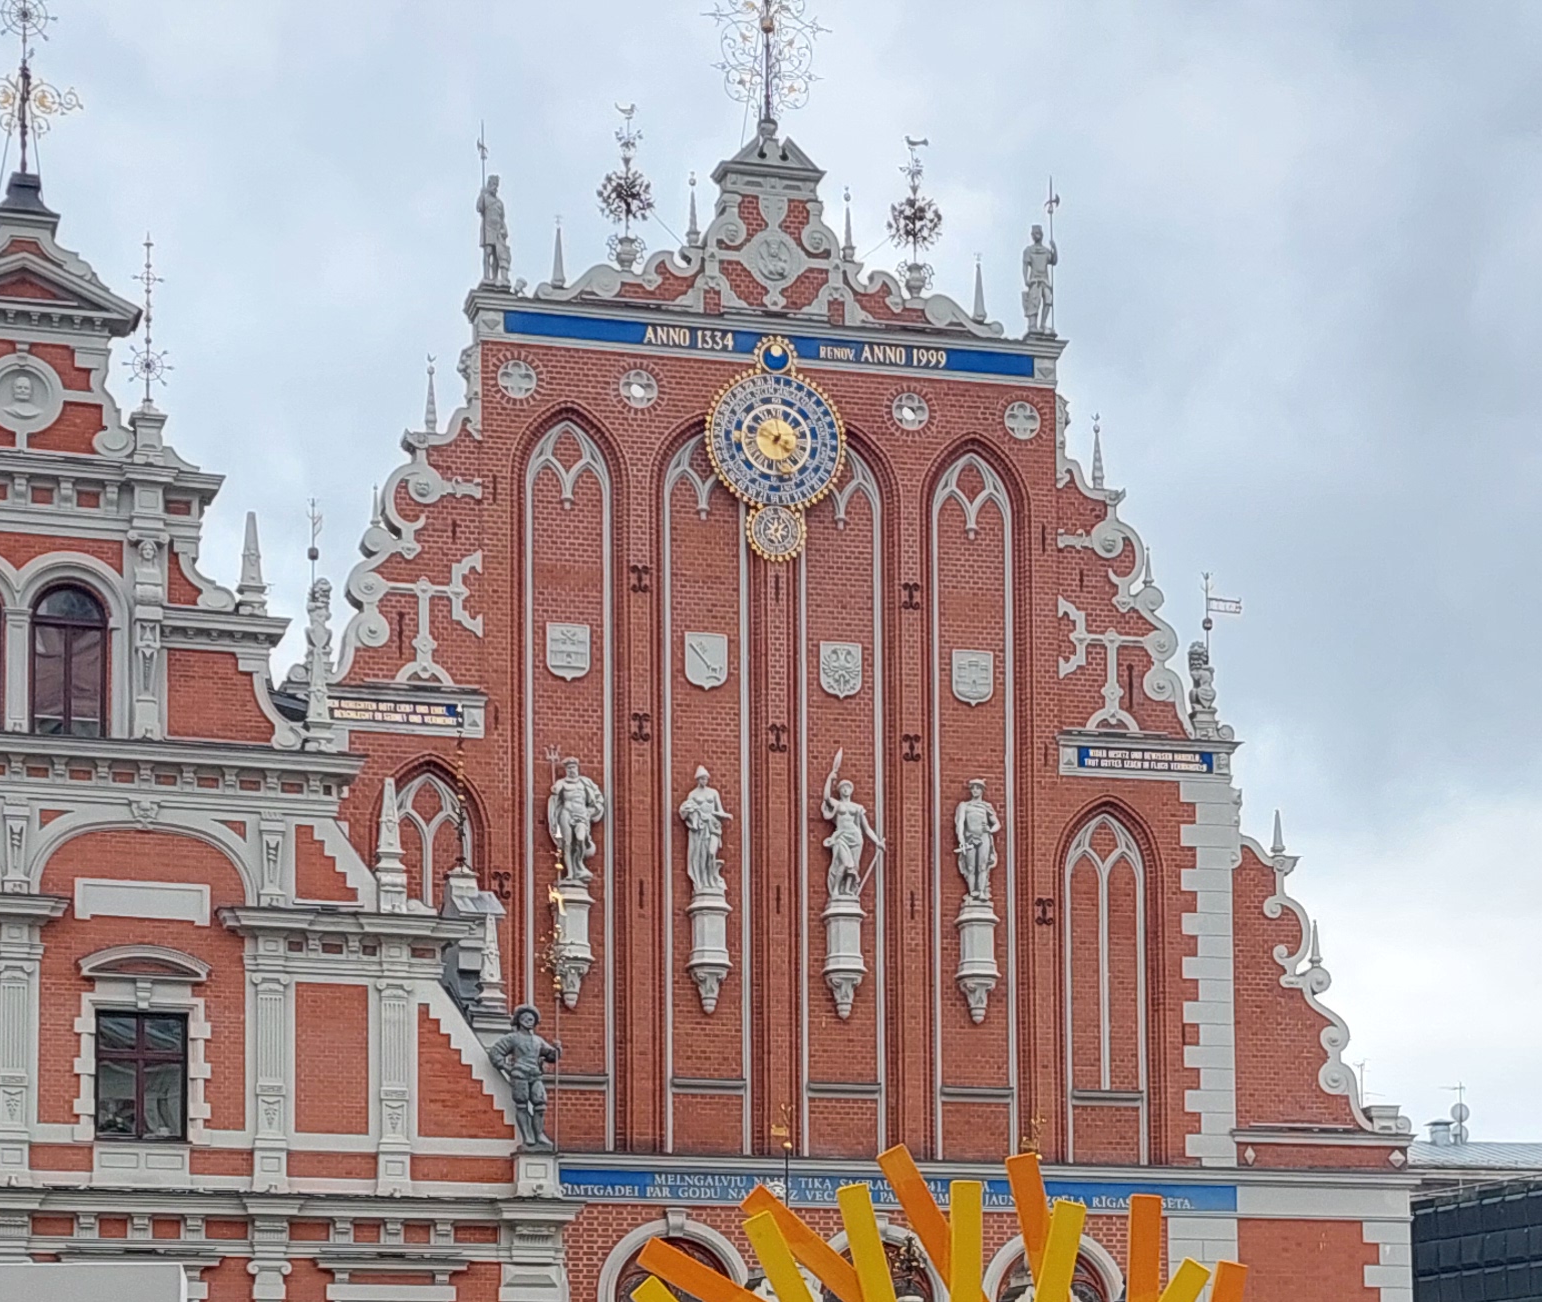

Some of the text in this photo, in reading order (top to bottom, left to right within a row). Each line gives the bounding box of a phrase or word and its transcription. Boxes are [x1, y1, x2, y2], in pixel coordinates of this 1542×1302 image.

[643, 325, 734, 351] ANNO 1334
[860, 344, 906, 365] ANNO
[912, 348, 947, 368] 1999
[645, 1186, 672, 1198] PAR
